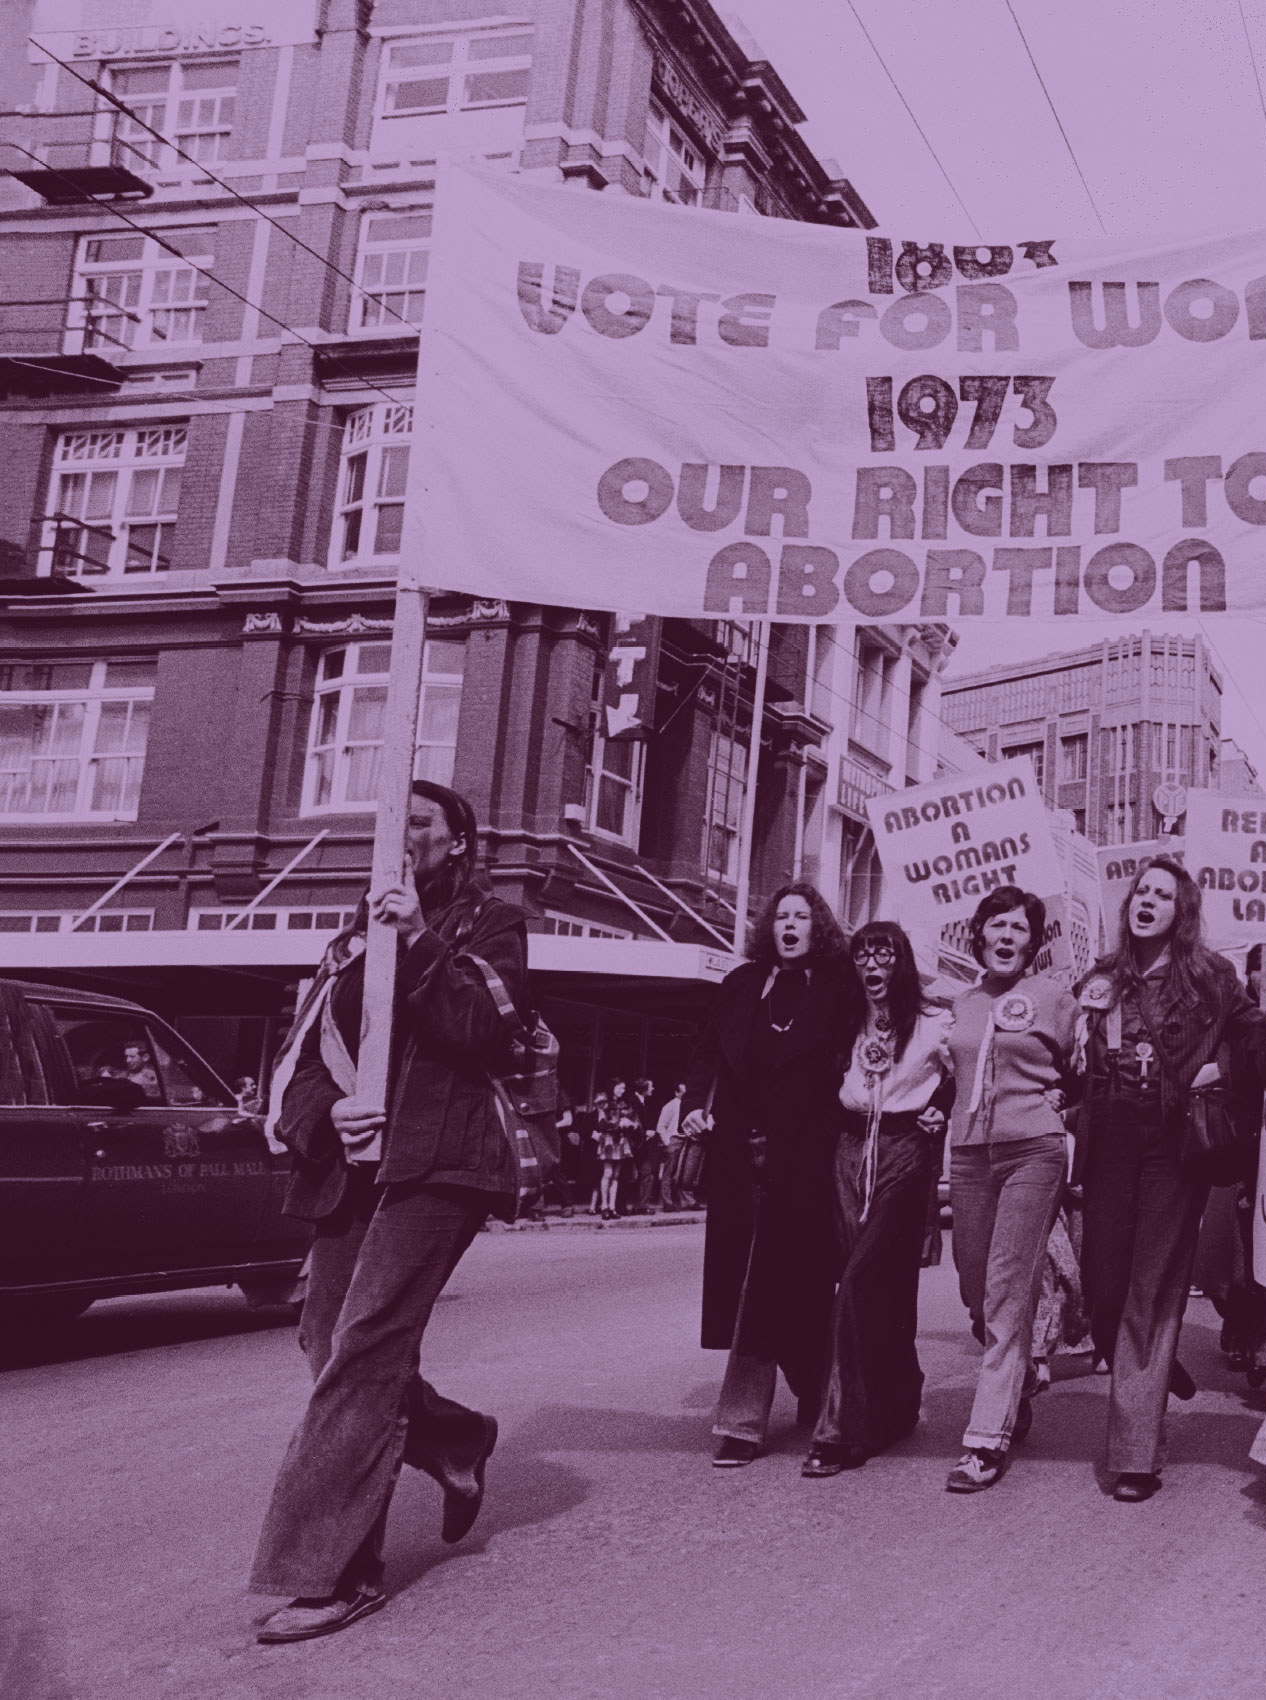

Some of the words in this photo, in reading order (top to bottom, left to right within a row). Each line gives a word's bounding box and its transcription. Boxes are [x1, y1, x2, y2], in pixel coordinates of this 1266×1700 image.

[516, 261, 777, 349] VOTE
[815, 283, 1020, 353] FOR
[866, 375, 1059, 453] 1973
[596, 457, 812, 539] OUR
[852, 461, 1140, 540] RIGHT
[703, 538, 1227, 618] ABORTION
[883, 777, 1026, 834] ABORTION
[951, 821, 971, 844] A
[904, 832, 1031, 884] WOMANS
[931, 864, 1017, 905] RIGHT
[92, 1164, 173, 1181] ROTHMANS
[178, 1163, 195, 1178] OF
